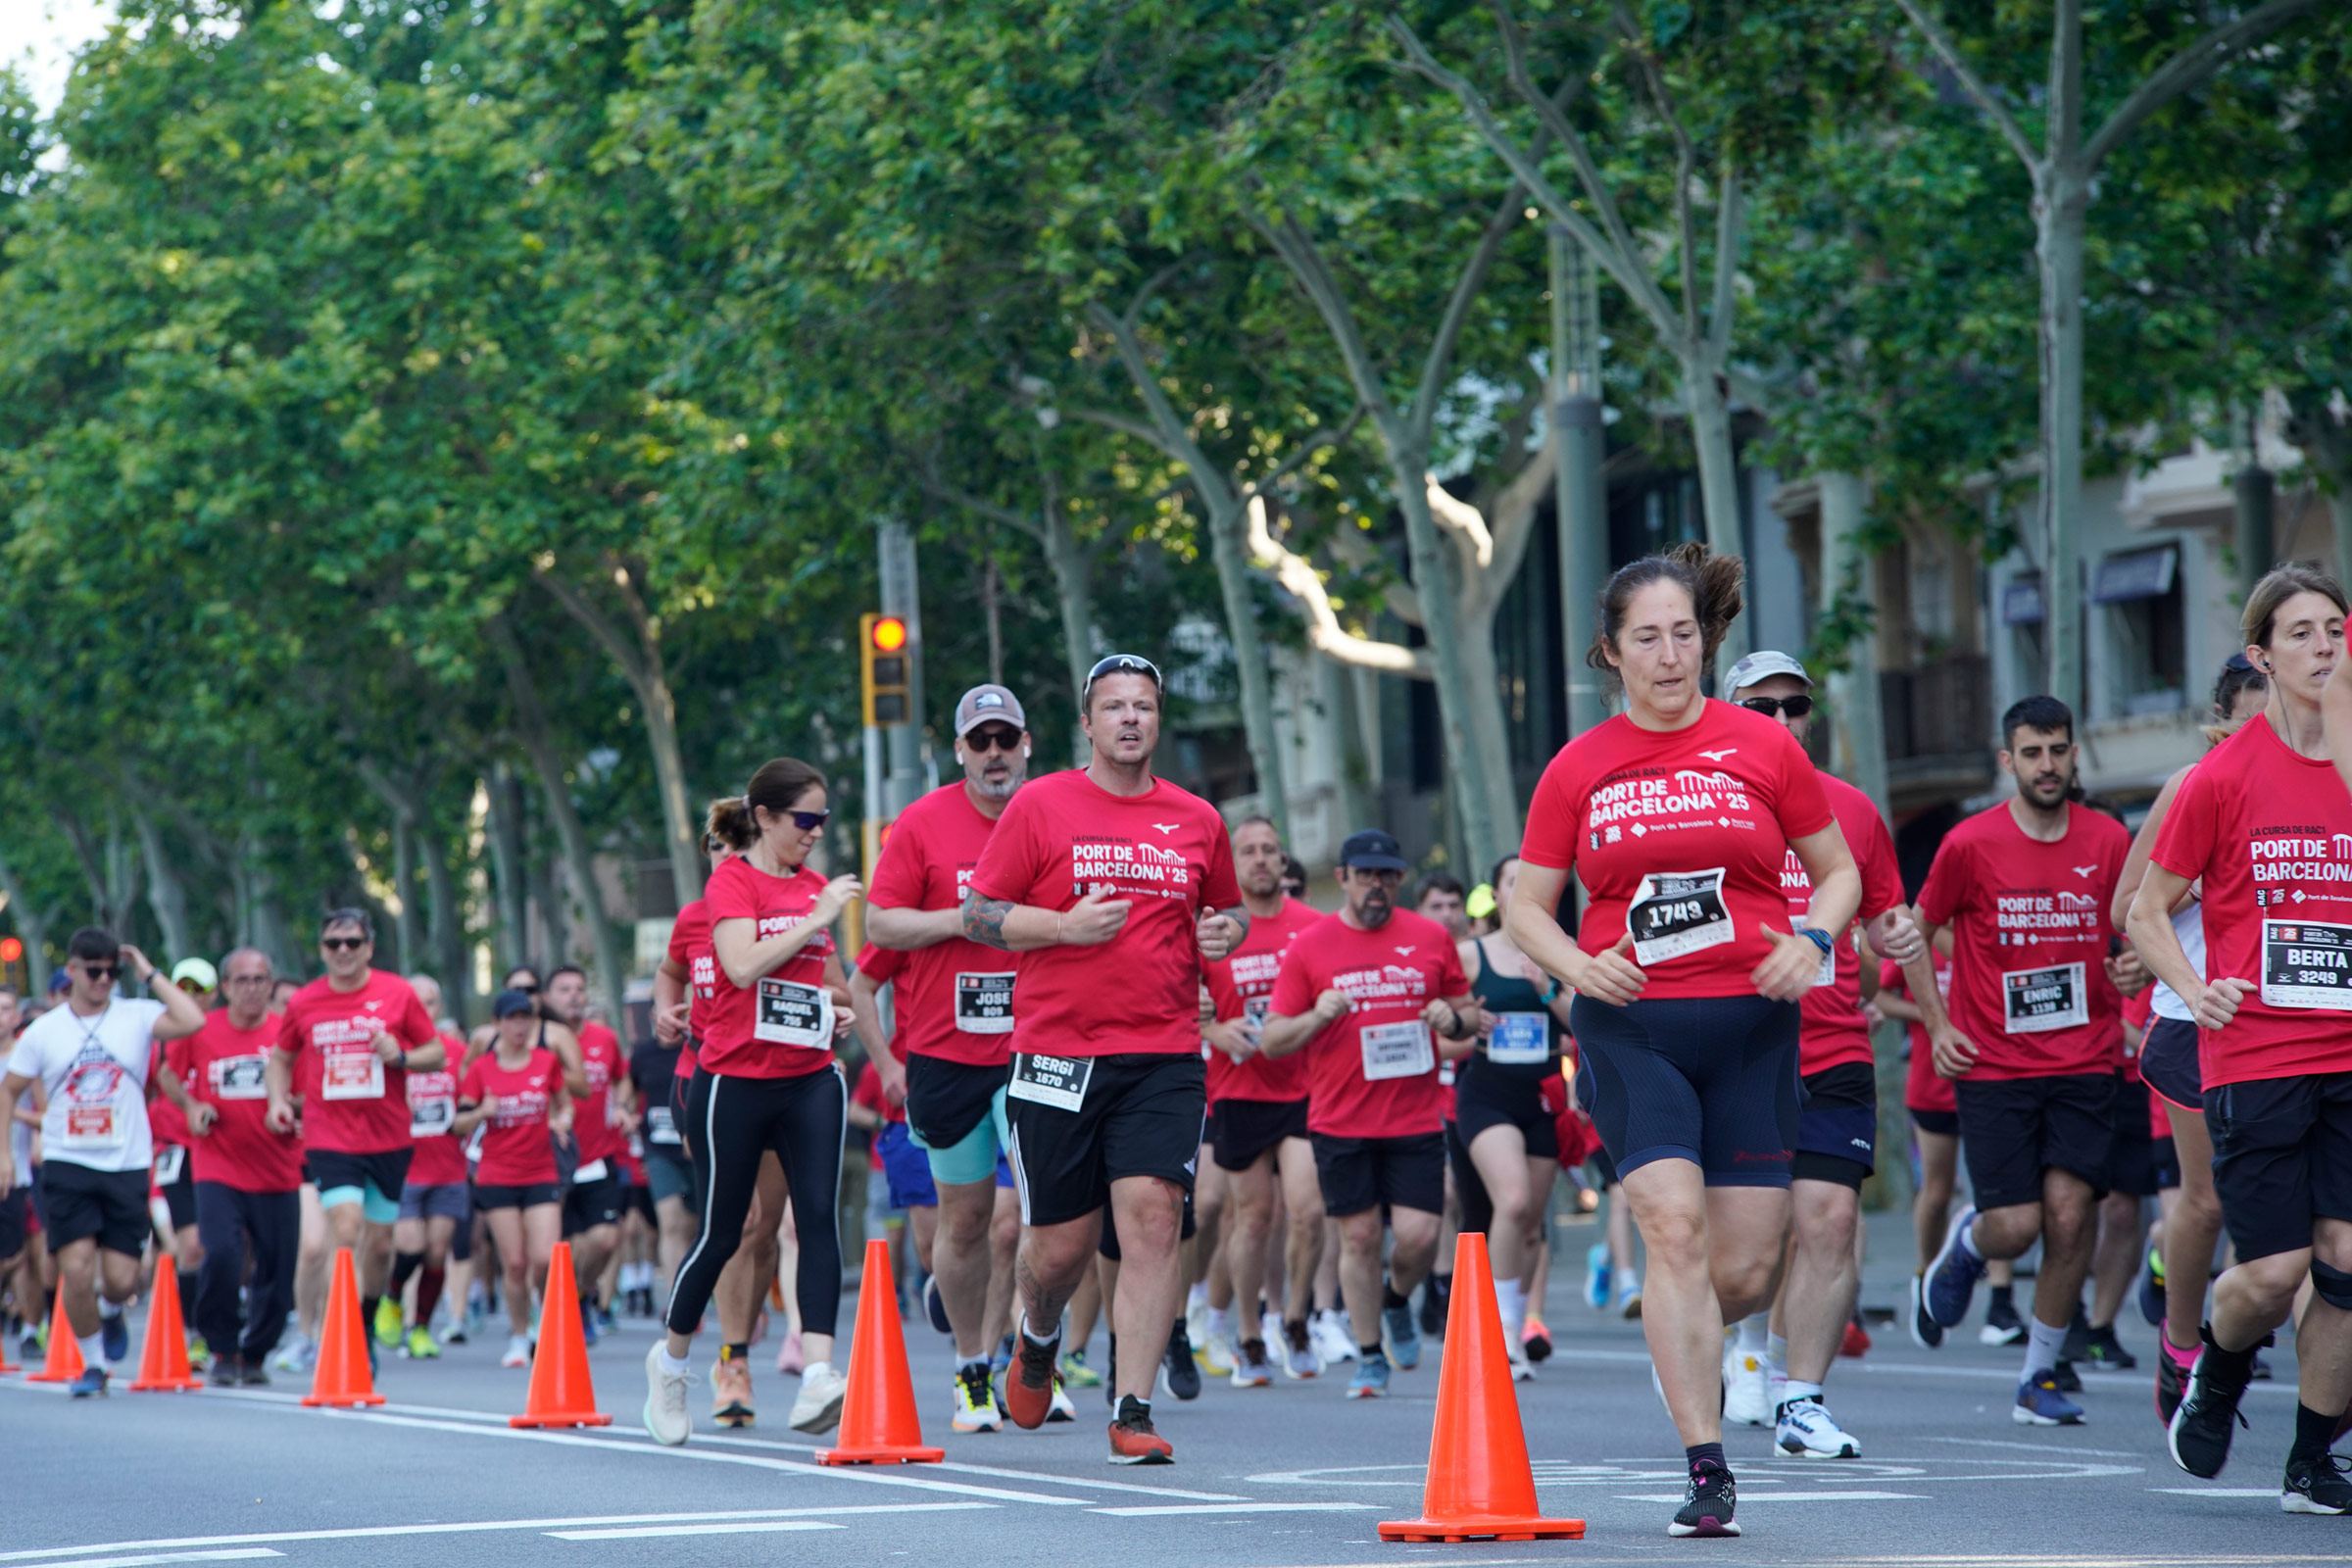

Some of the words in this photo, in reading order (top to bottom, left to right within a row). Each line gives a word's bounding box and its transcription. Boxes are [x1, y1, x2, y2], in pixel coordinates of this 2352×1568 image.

[1590, 781, 1639, 810] PORT
[1640, 779, 1668, 797] DE
[1590, 792, 1717, 829] BARCELONA
[1716, 791, 1750, 811] '25
[1678, 819, 1714, 829] Barcelona
[2250, 827, 2261, 837] LA
[2262, 825, 2291, 836] CURSA
[2292, 825, 2303, 835] DE
[2304, 825, 2327, 835] RAC1
[1072, 844, 1112, 861] PORT
[1113, 845, 1134, 861] DE
[2250, 839, 2301, 860] PORT
[2302, 839, 2328, 858] DE
[1073, 861, 1165, 881] BARCELONA
[1165, 865, 1188, 884] '25
[1997, 897, 2034, 912] PORT
[2034, 897, 2054, 912] DE
[1997, 912, 2081, 928] BARCELONA
[2287, 948, 2349, 968] BERTA
[1332, 971, 1363, 989] PORT
[1363, 969, 1382, 984] DE
[2298, 969, 2338, 985] 3249
[975, 992, 1010, 1005] JOSE
[2023, 985, 2063, 1004] ENRIC
[771, 999, 813, 1016] RAQUEL
[1032, 1054, 1075, 1077] SERGI
[1035, 1071, 1063, 1088] 1670
